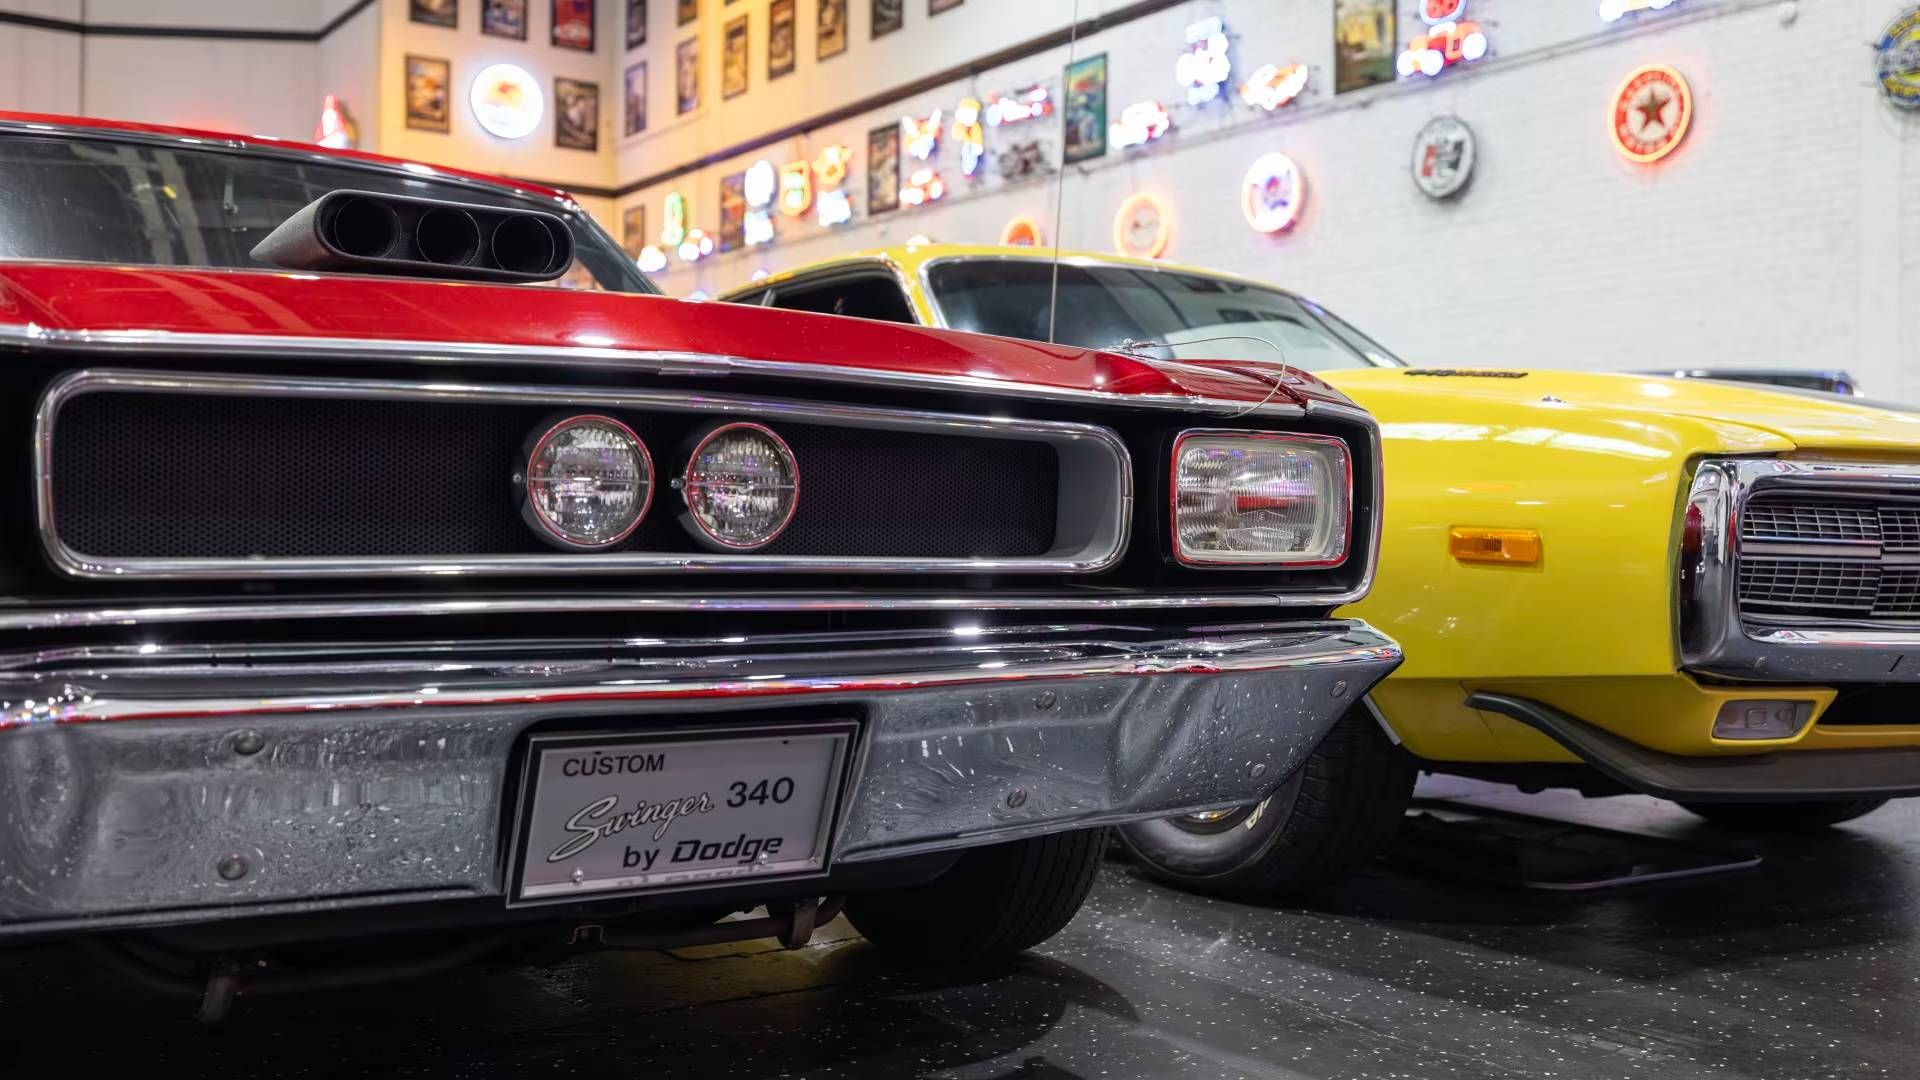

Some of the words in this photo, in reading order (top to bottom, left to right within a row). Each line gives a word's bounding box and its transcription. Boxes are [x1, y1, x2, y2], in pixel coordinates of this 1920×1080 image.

[563, 754, 665, 777] CUSTOM
[547, 793, 715, 863] Swinger
[727, 777, 795, 808] 340
[623, 846, 660, 871] by
[670, 834, 783, 864] Dodge
